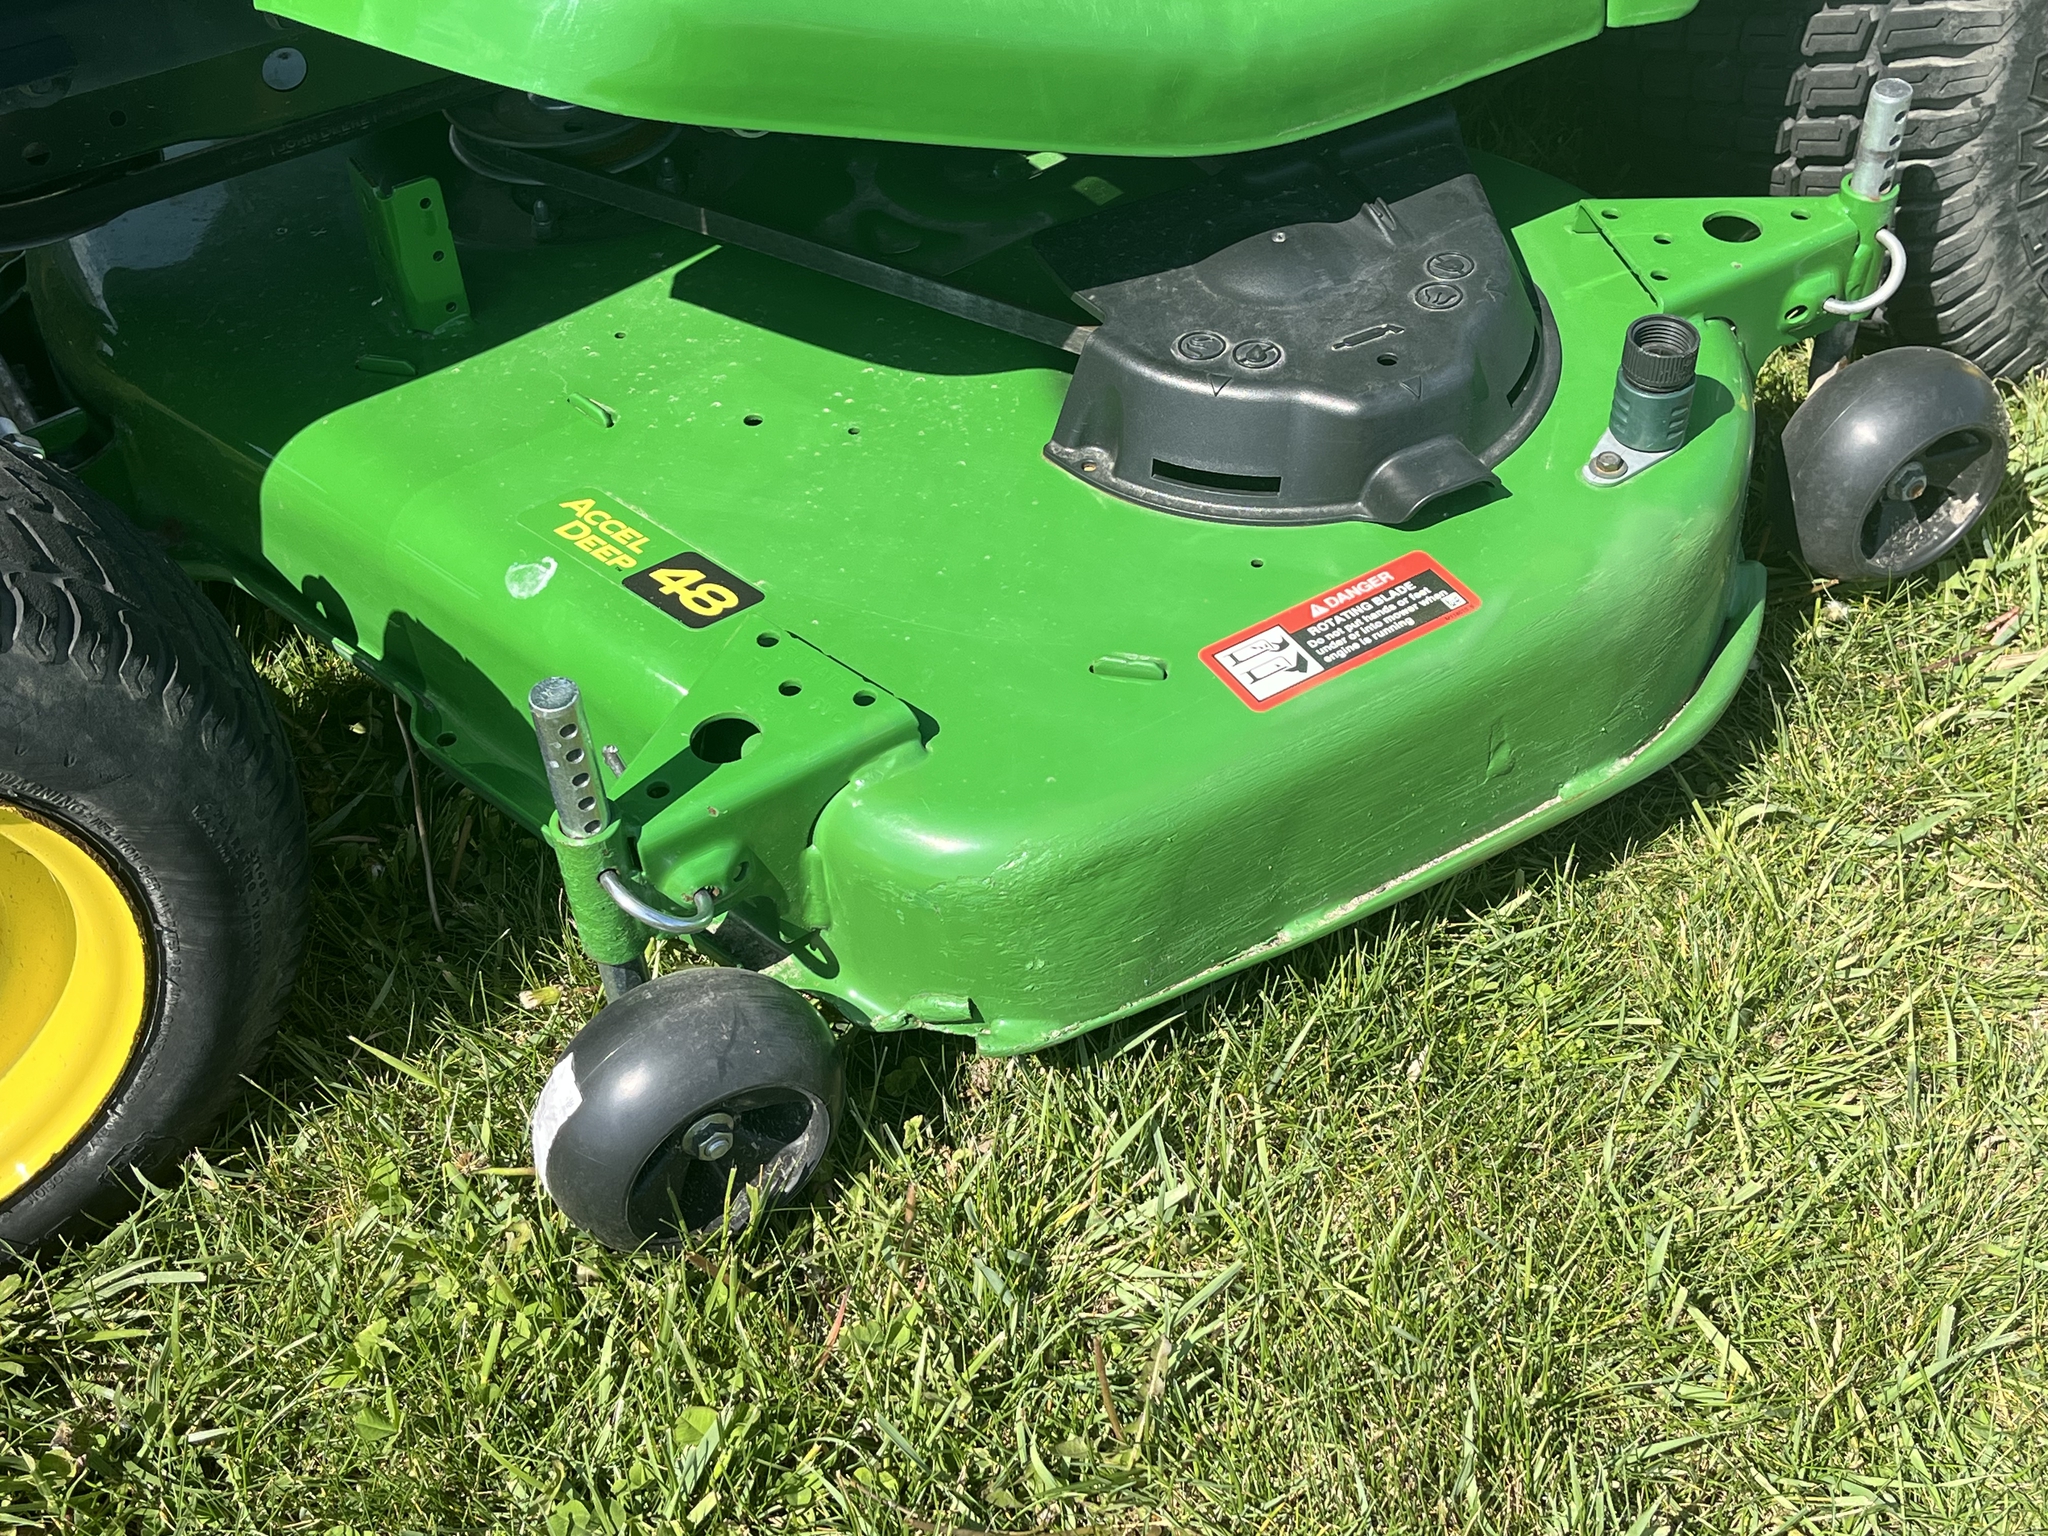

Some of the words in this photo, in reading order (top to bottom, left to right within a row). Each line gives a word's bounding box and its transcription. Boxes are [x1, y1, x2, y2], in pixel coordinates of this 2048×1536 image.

[553, 519, 637, 568] DEEP
[559, 498, 650, 554] ACCEL
[649, 568, 739, 617] 48
[1307, 601, 1374, 636] ROTATING
[1371, 581, 1417, 606] BLADE
[1323, 571, 1395, 609] DANGER
[1306, 637, 1326, 649] Do
[1324, 627, 1346, 640] not
[1344, 618, 1365, 633] put
[1361, 604, 1397, 623] hands
[1396, 597, 1410, 607] or
[1408, 586, 1432, 601] feet
[1315, 637, 1348, 656] under
[1348, 630, 1361, 640] or
[1360, 620, 1384, 634] into
[1382, 603, 1419, 624] mower
[1418, 589, 1449, 607] when
[1323, 642, 1361, 663] engine
[1358, 636, 1373, 646] is
[1371, 616, 1416, 641] running
